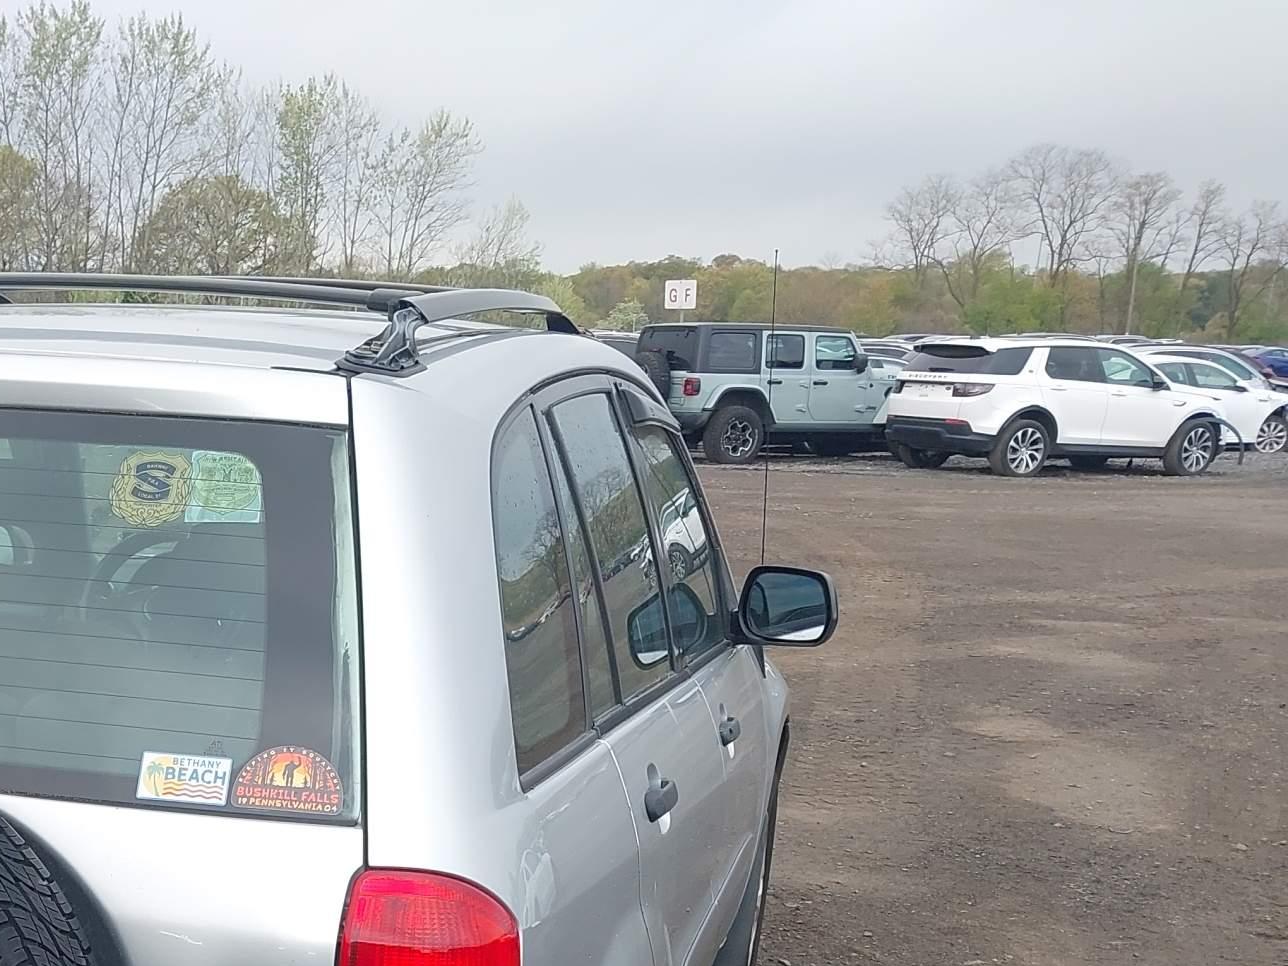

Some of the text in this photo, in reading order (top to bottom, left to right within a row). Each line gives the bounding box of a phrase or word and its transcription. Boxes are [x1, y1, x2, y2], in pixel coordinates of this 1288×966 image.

[172, 757, 222, 769] BETHANY
[164, 766, 227, 787] BEACH
[236, 785, 339, 804] BUSHKILL FALLS
[249, 798, 323, 812] PENNSYLVANIA
